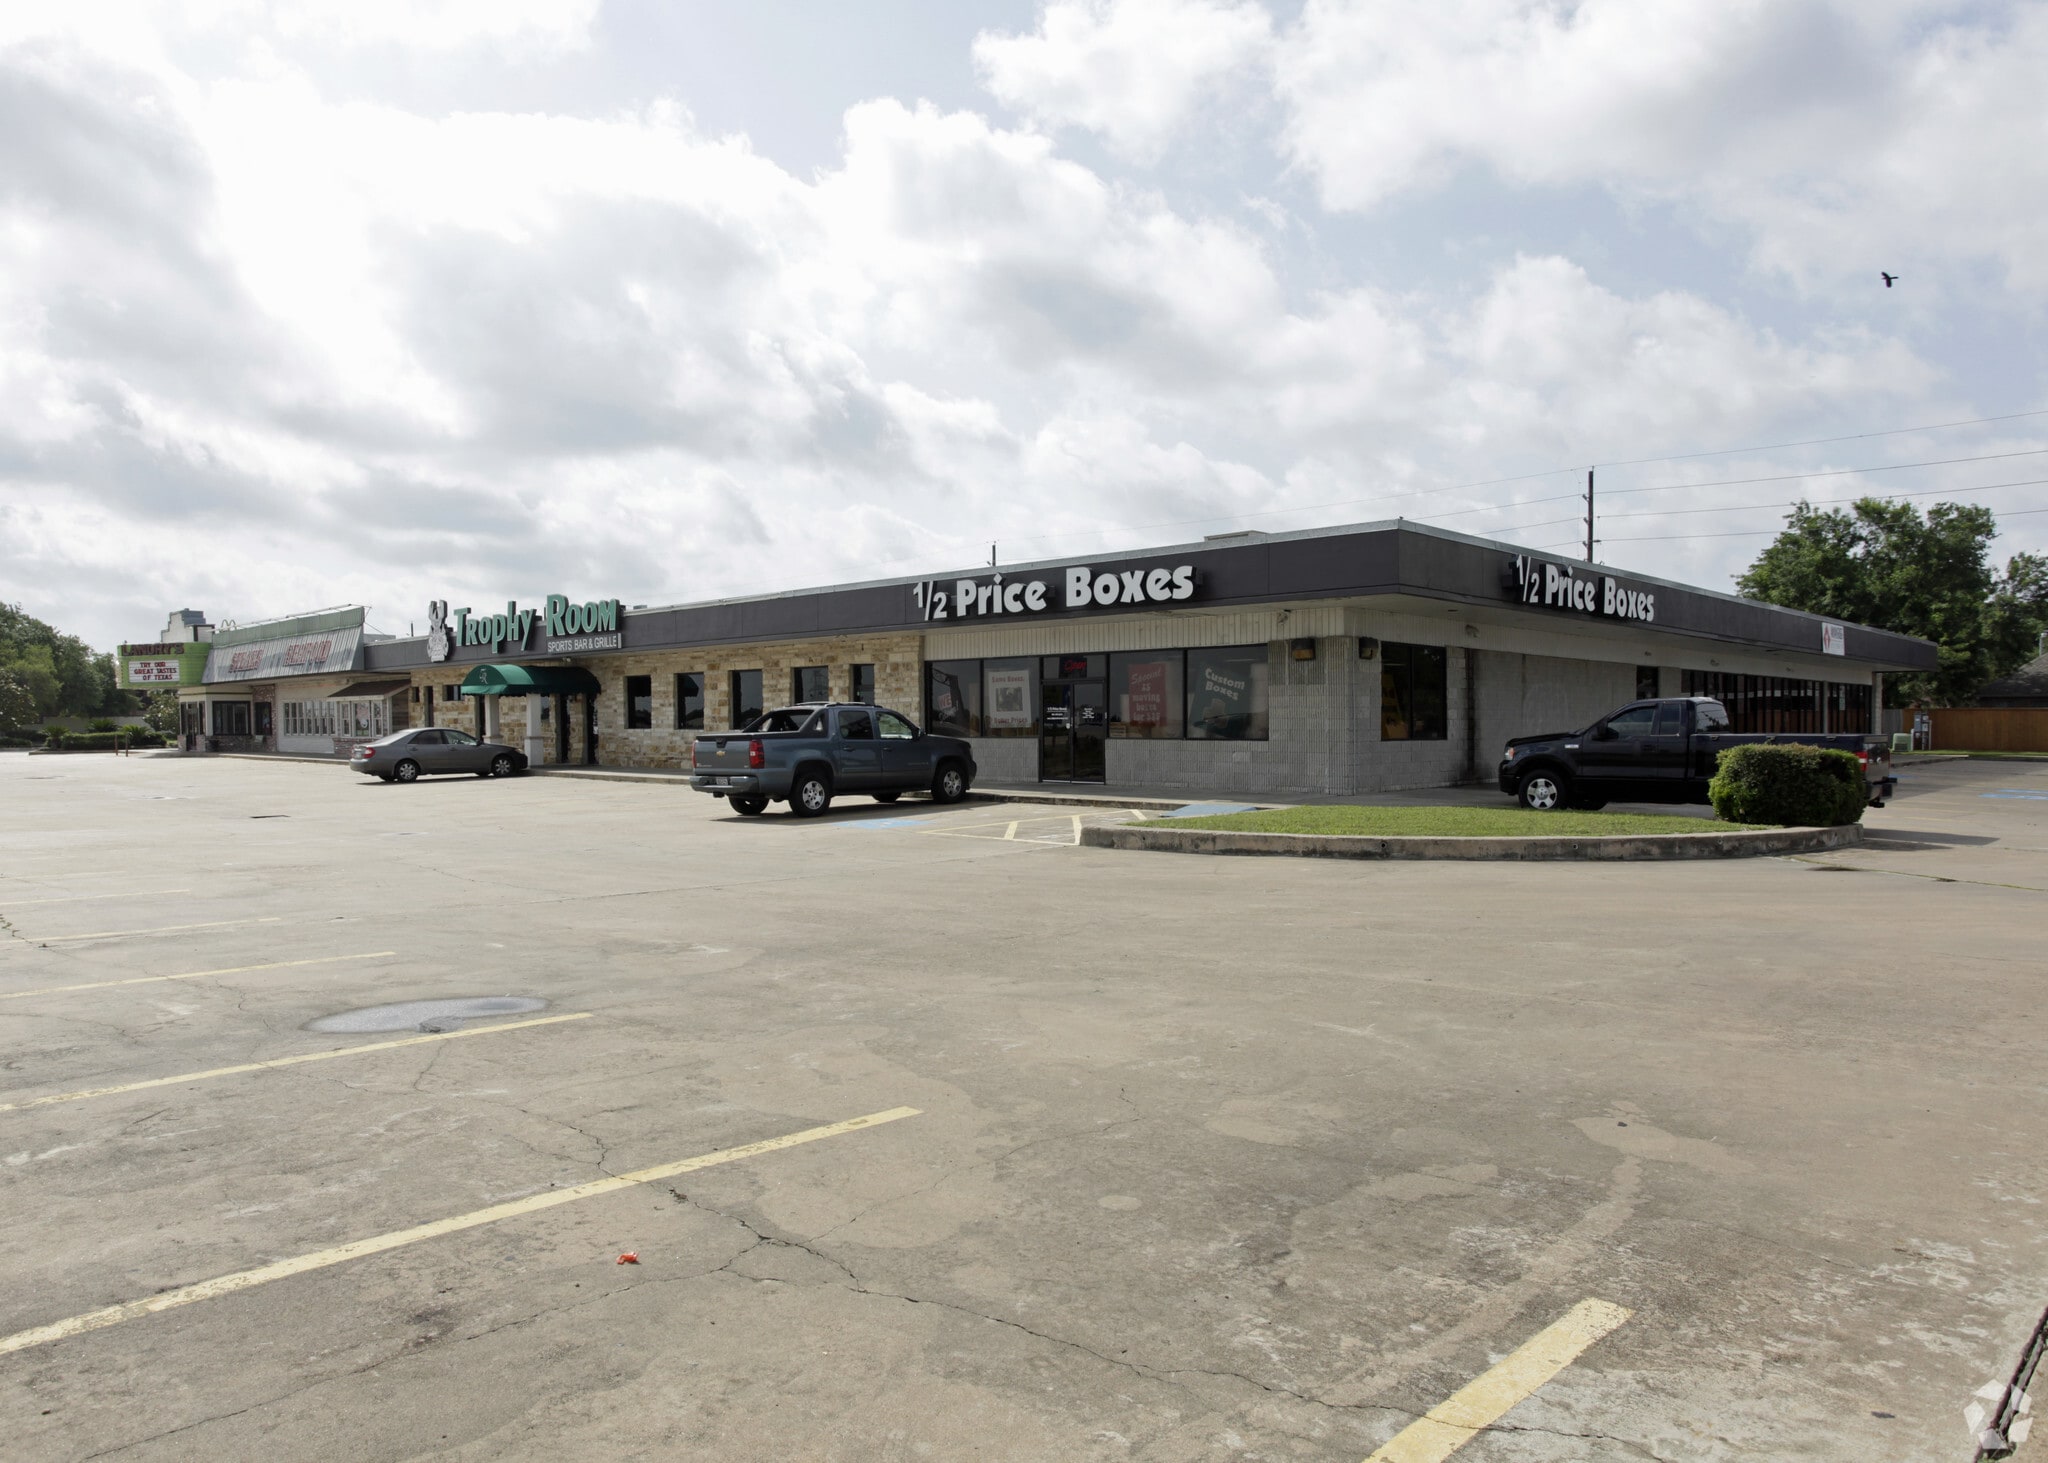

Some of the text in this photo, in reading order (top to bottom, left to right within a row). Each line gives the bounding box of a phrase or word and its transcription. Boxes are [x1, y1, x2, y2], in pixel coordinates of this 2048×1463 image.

[913, 565, 1194, 621] 1/2 Price Boxes
[1516, 553, 1655, 622] 1/2 Price Boxes
[547, 641, 573, 652] SPORTS
[574, 638, 588, 650] BAR
[594, 635, 617, 648] GRILLE
[1205, 668, 1245, 690] Custom
[1205, 681, 1239, 700] Boxes
